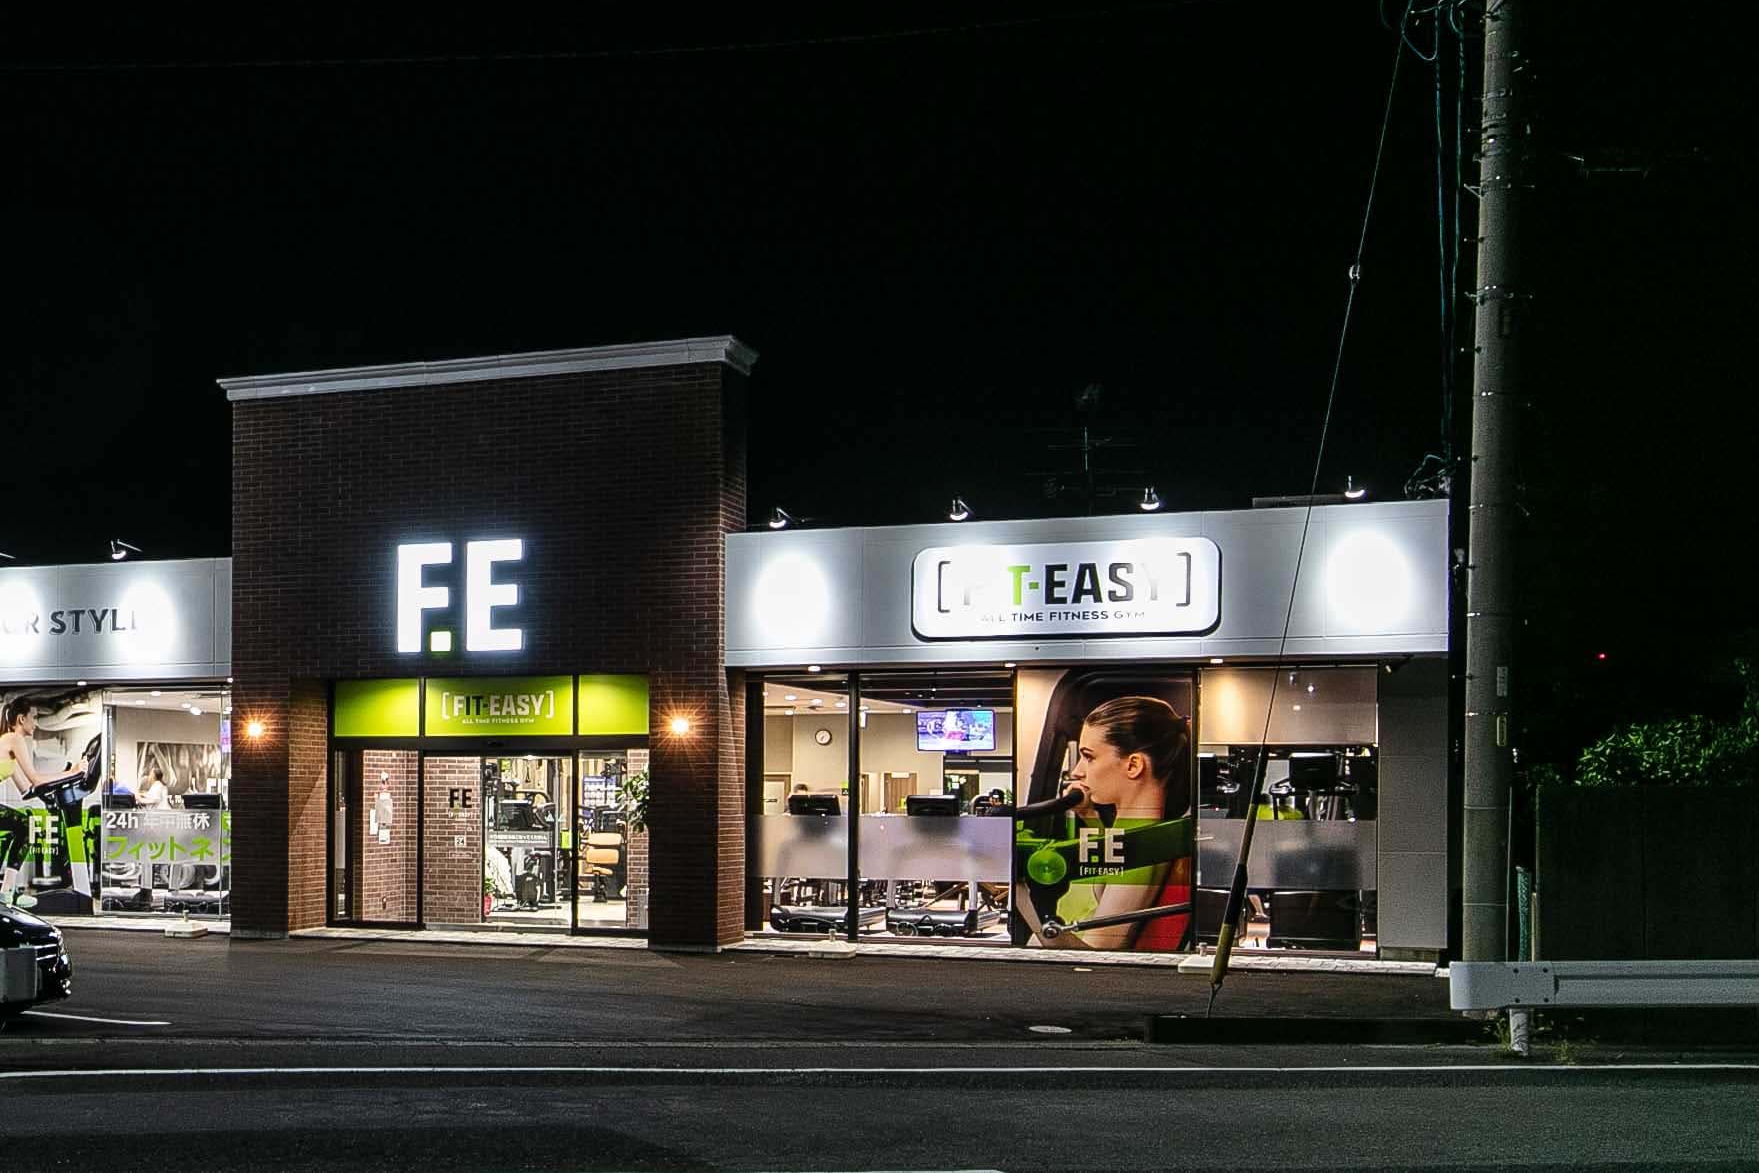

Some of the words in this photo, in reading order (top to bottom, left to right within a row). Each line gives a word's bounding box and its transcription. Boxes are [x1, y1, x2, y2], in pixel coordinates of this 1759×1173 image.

[1011, 612, 1044, 623] TIME
[1049, 610, 1109, 622] FITNESS
[1113, 610, 1145, 620] GYM
[106, 812, 139, 829] 24h
[106, 835, 231, 861] フィットネ
